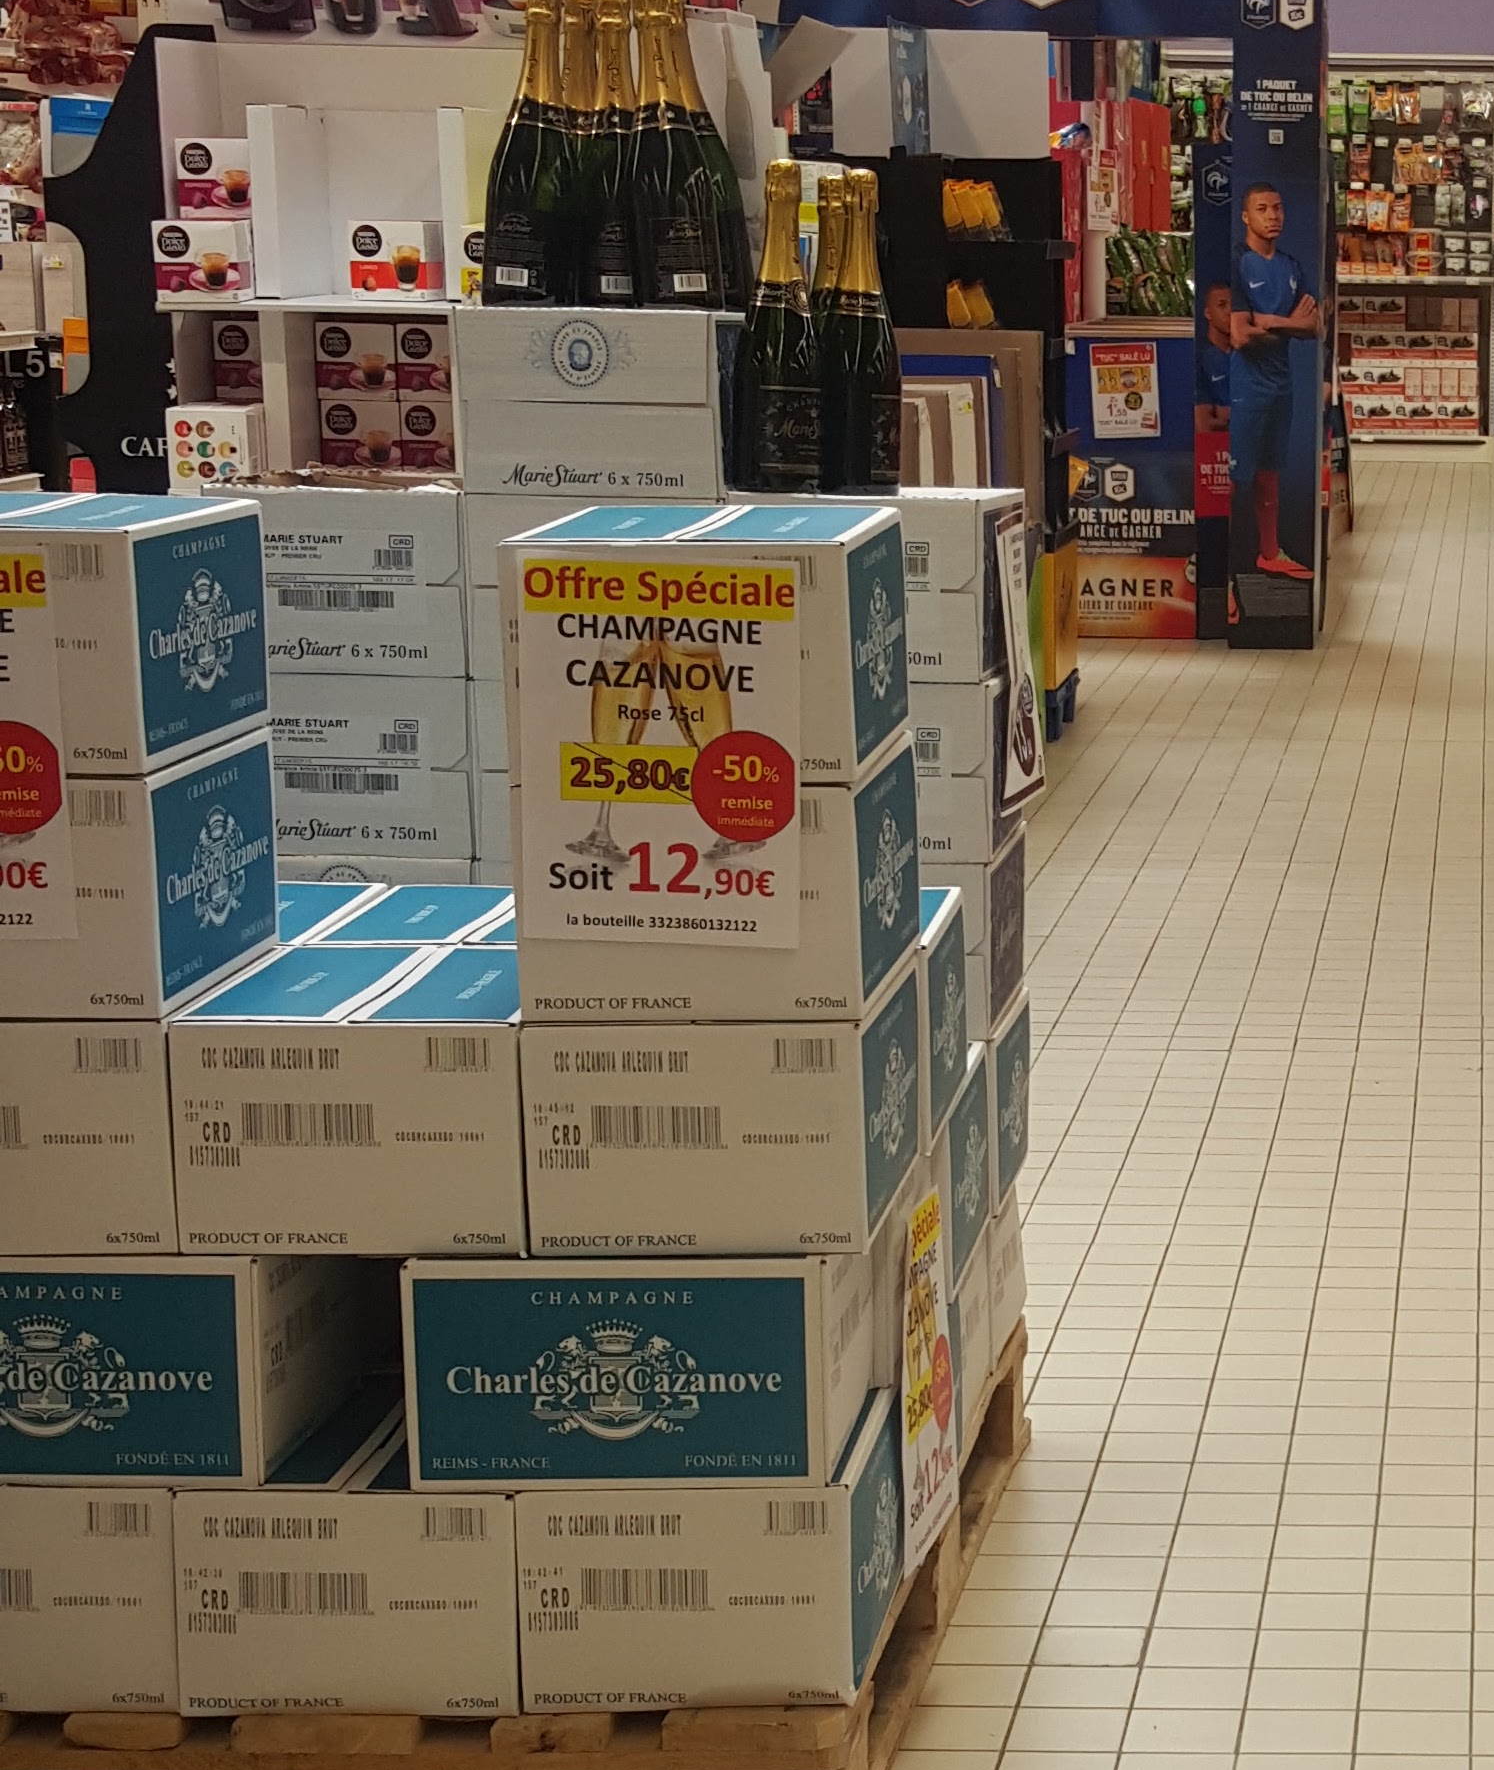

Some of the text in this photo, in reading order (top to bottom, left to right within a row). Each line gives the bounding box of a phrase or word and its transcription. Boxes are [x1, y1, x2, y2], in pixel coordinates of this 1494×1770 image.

[607, 471, 685, 488] 6 x 750ml
[1078, 508, 1195, 525] DE TUC OU BELIN
[172, 534, 227, 559] CHAMPAGNE
[298, 534, 344, 545] STUART
[523, 566, 795, 611] Offre Spéciale
[150, 627, 194, 661] Charles
[208, 608, 257, 640] Cazanove
[556, 613, 763, 646] CHAMPAGNE
[351, 644, 429, 660] 6 750ml
[565, 659, 755, 693] CAZANOVE
[617, 703, 705, 723] Rose 75cl
[304, 718, 350, 729] STUART
[72, 746, 128, 761] 6x750ml
[569, 756, 691, 793] 25,80€
[711, 755, 780, 784] -50%
[720, 795, 774, 811] remise
[717, 814, 775, 828] immédiate
[548, 841, 776, 900] Soit 12,90€
[566, 913, 758, 933] la bouteille 3323860132122
[535, 996, 848, 1011] PRODUCT OF FRANCE 6x750ml
[202, 1121, 232, 1143] CRD
[552, 1124, 582, 1146] CRD
[188, 1232, 506, 1246] PRODUCT OF FRANCE 6x750ml
[530, 1290, 695, 1306] CHAMPAGNE
[53, 1363, 213, 1392] Cazanove
[446, 1365, 783, 1397] Charles de Cazanove
[116, 1451, 229, 1467] FONDÉ EN 1811
[433, 1455, 549, 1470] REIMS FRANCE
